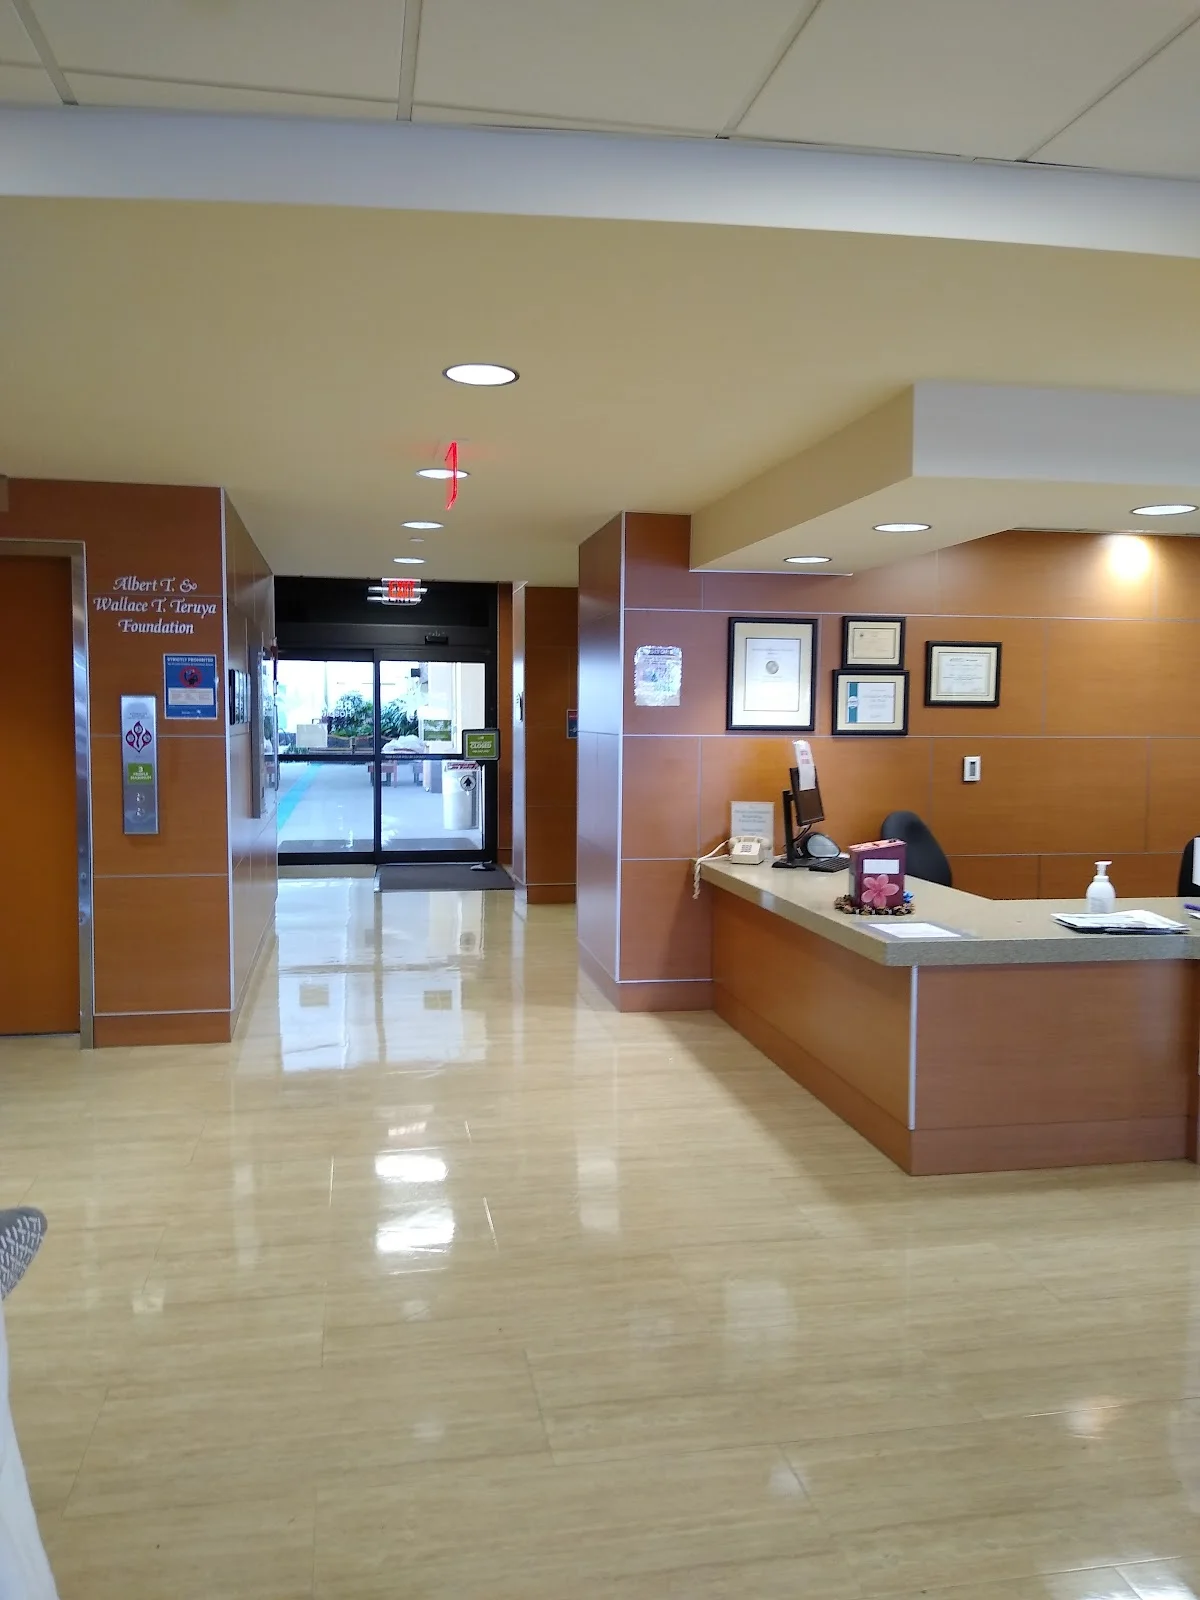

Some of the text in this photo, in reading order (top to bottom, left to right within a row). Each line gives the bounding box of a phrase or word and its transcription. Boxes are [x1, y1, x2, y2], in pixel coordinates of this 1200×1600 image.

[112, 576, 198, 593] Albert T. &
[93, 597, 217, 619] Wallace T. Teruya
[118, 618, 195, 634] Foundation
